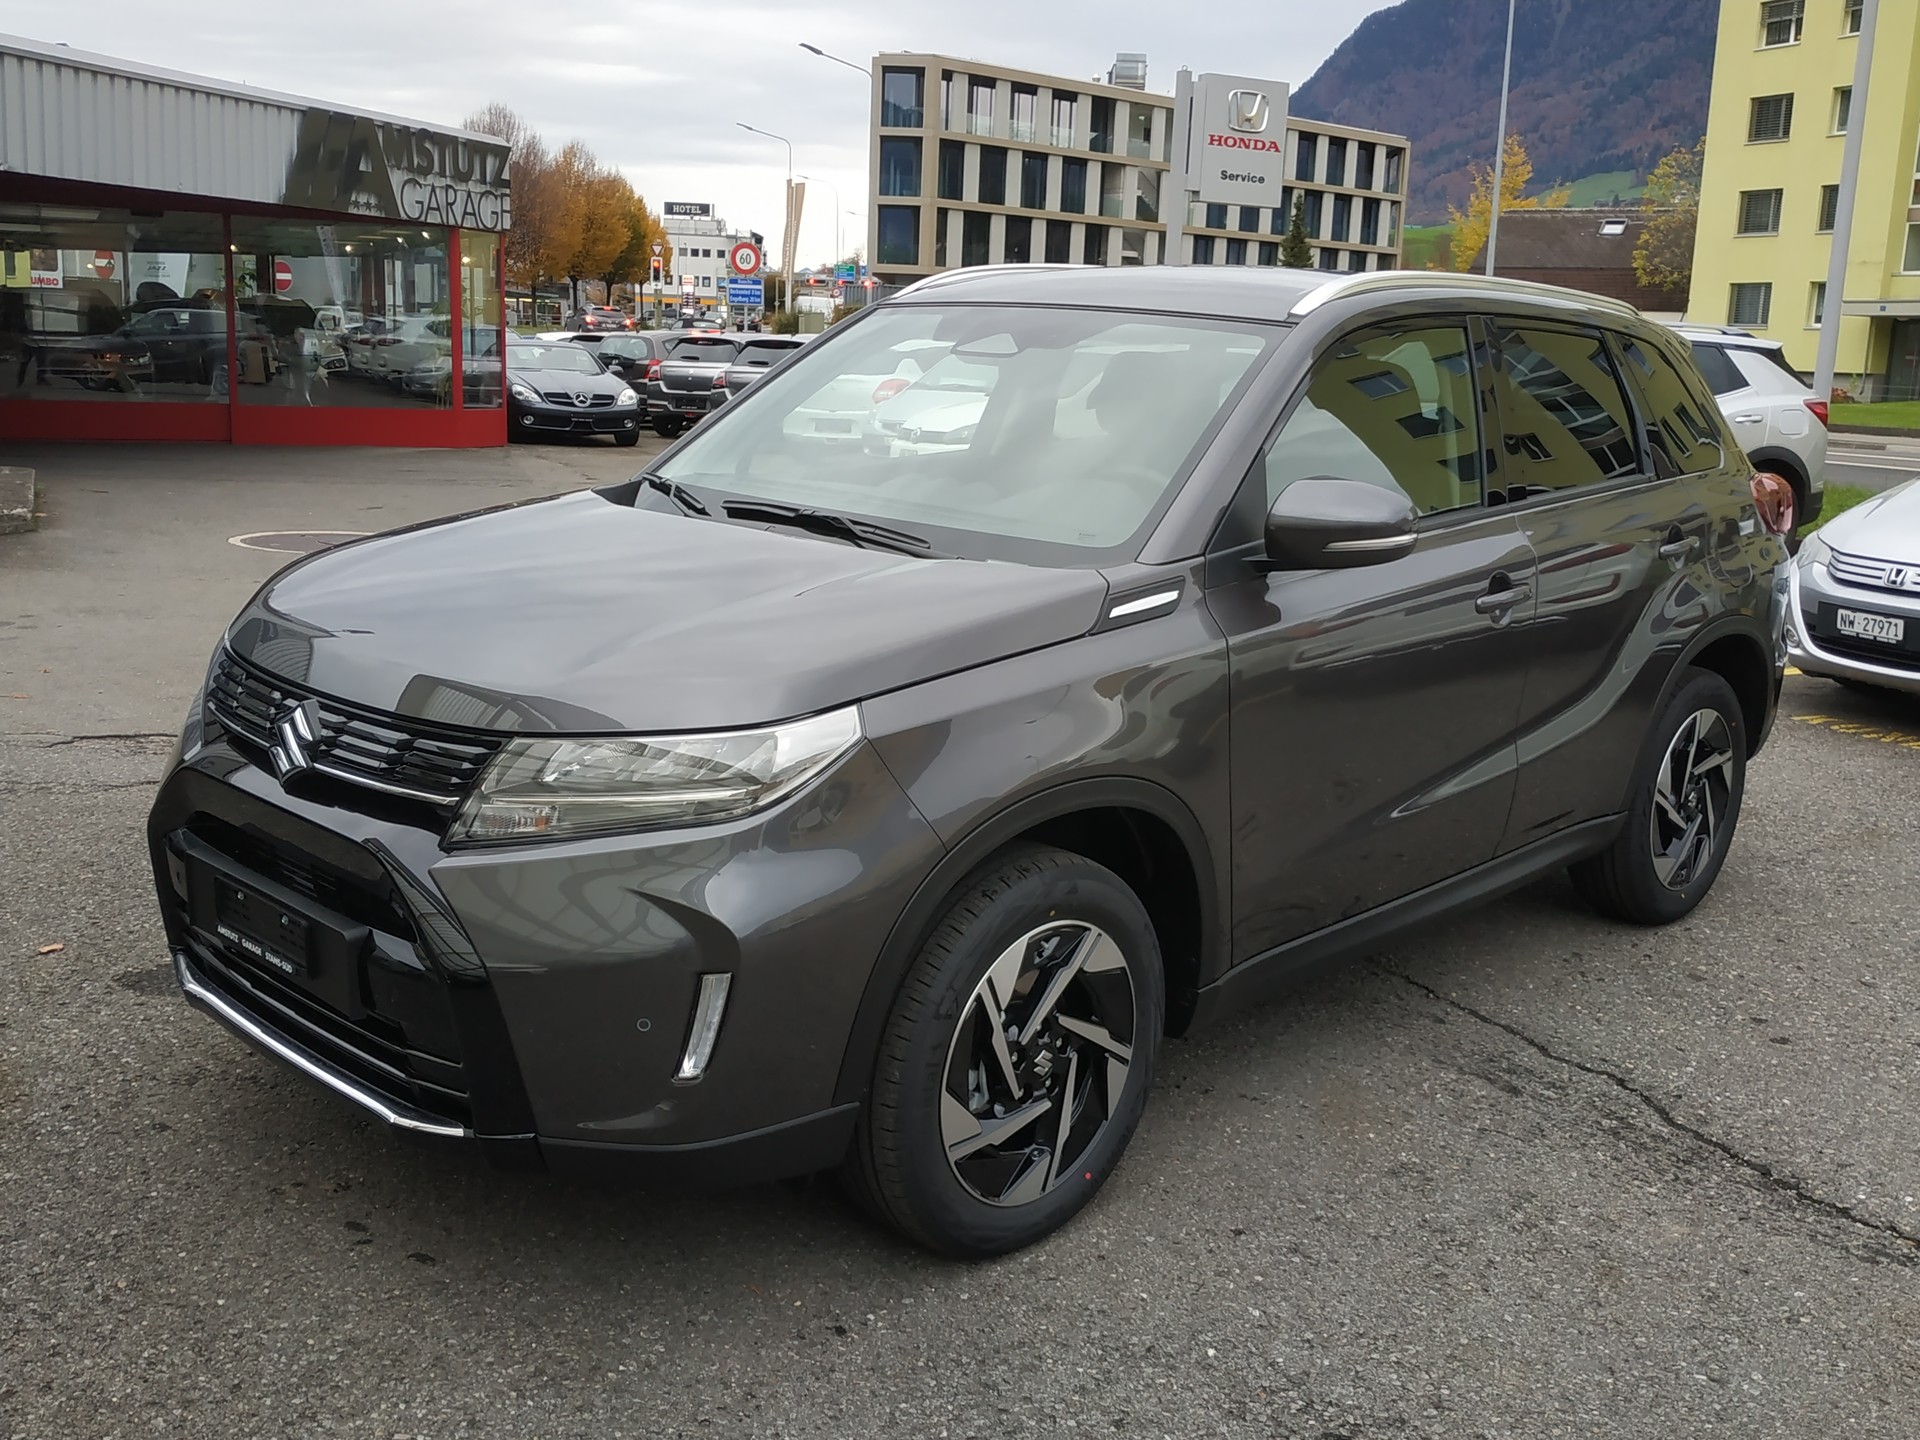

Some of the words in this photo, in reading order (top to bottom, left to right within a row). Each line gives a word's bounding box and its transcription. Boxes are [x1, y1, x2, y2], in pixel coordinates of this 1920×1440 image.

[1208, 134, 1281, 153] HONDA
[1220, 170, 1265, 184] Service
[400, 177, 511, 231] GARAGE
[672, 204, 702, 214] HOTEL
[739, 252, 752, 265] 60
[241, 938, 262, 956] GARAGE
